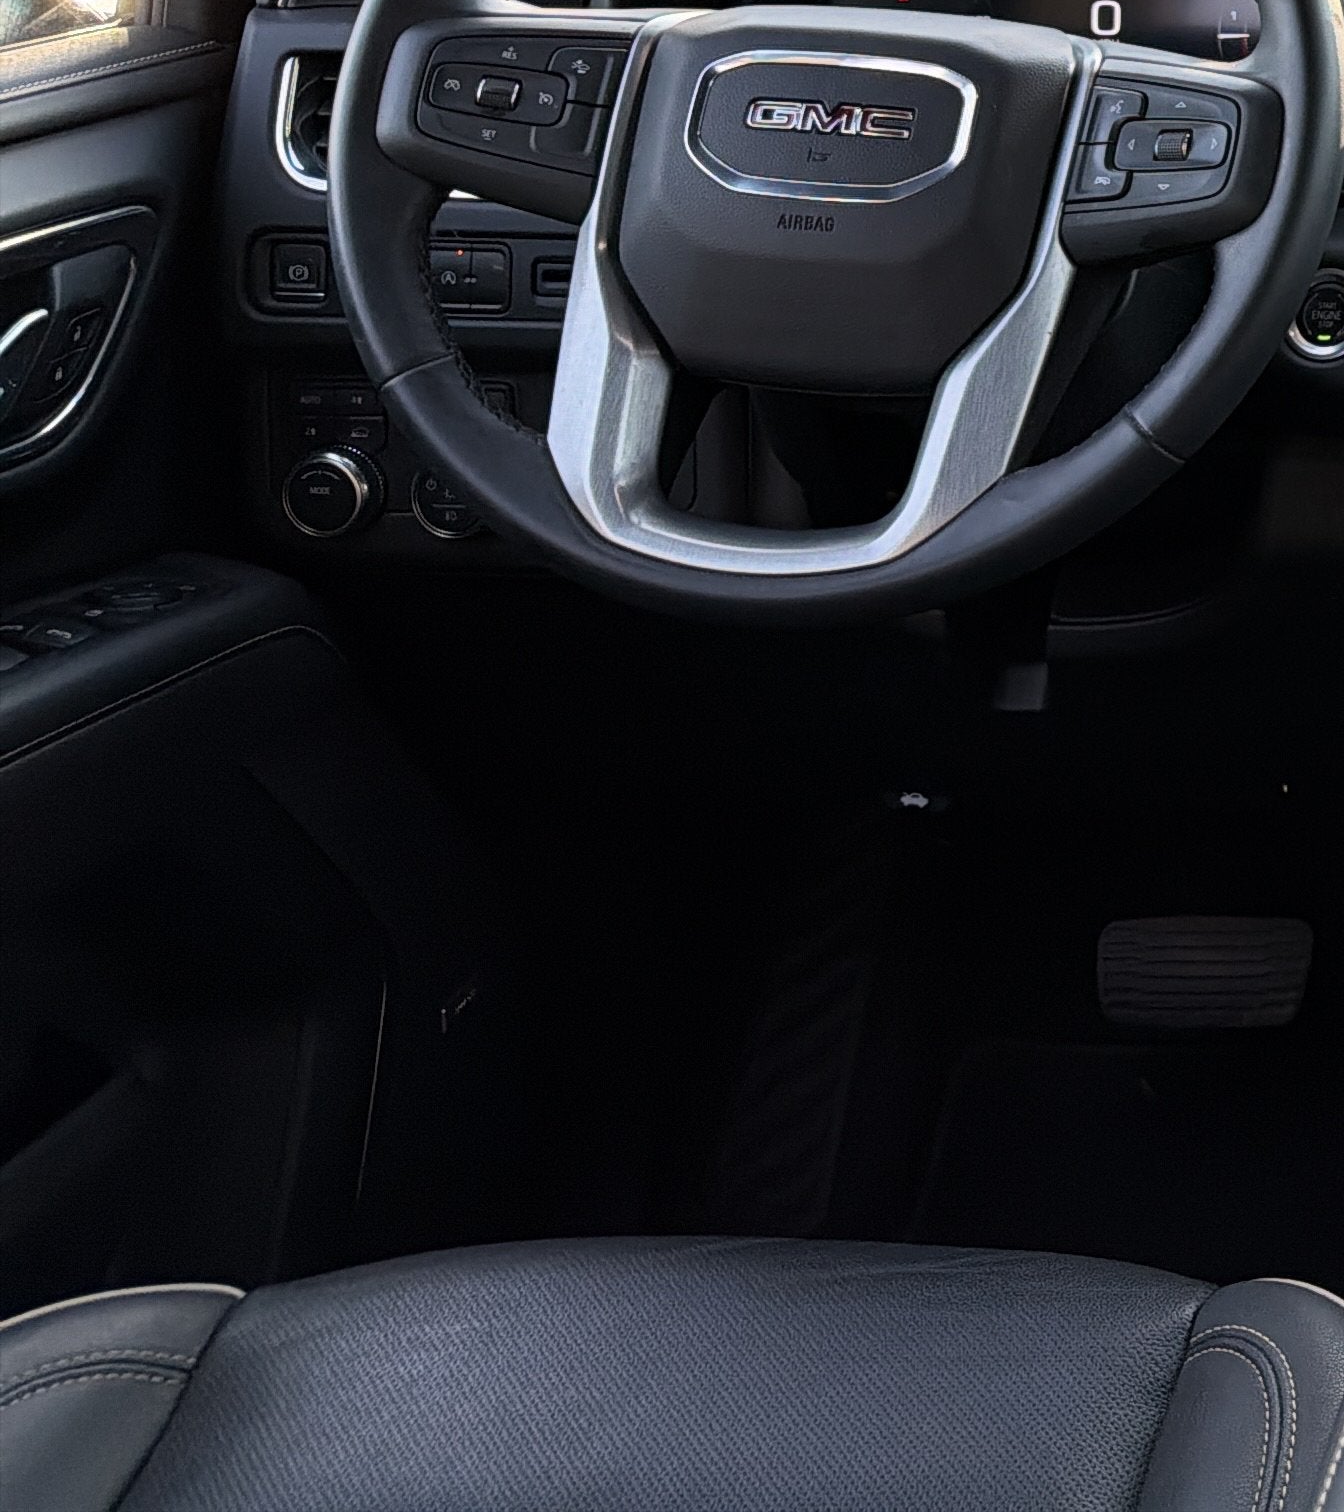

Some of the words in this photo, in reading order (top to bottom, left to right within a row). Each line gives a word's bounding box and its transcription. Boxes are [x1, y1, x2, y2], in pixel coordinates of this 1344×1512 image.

[1090, 0, 1122, 36] 0
[1230, 10, 1237, 21] 1
[501, 50, 518, 60] RES
[747, 99, 915, 139] GMC
[481, 129, 496, 138] SET
[776, 213, 835, 233] AIRBAG
[1312, 310, 1342, 320] ENGINE
